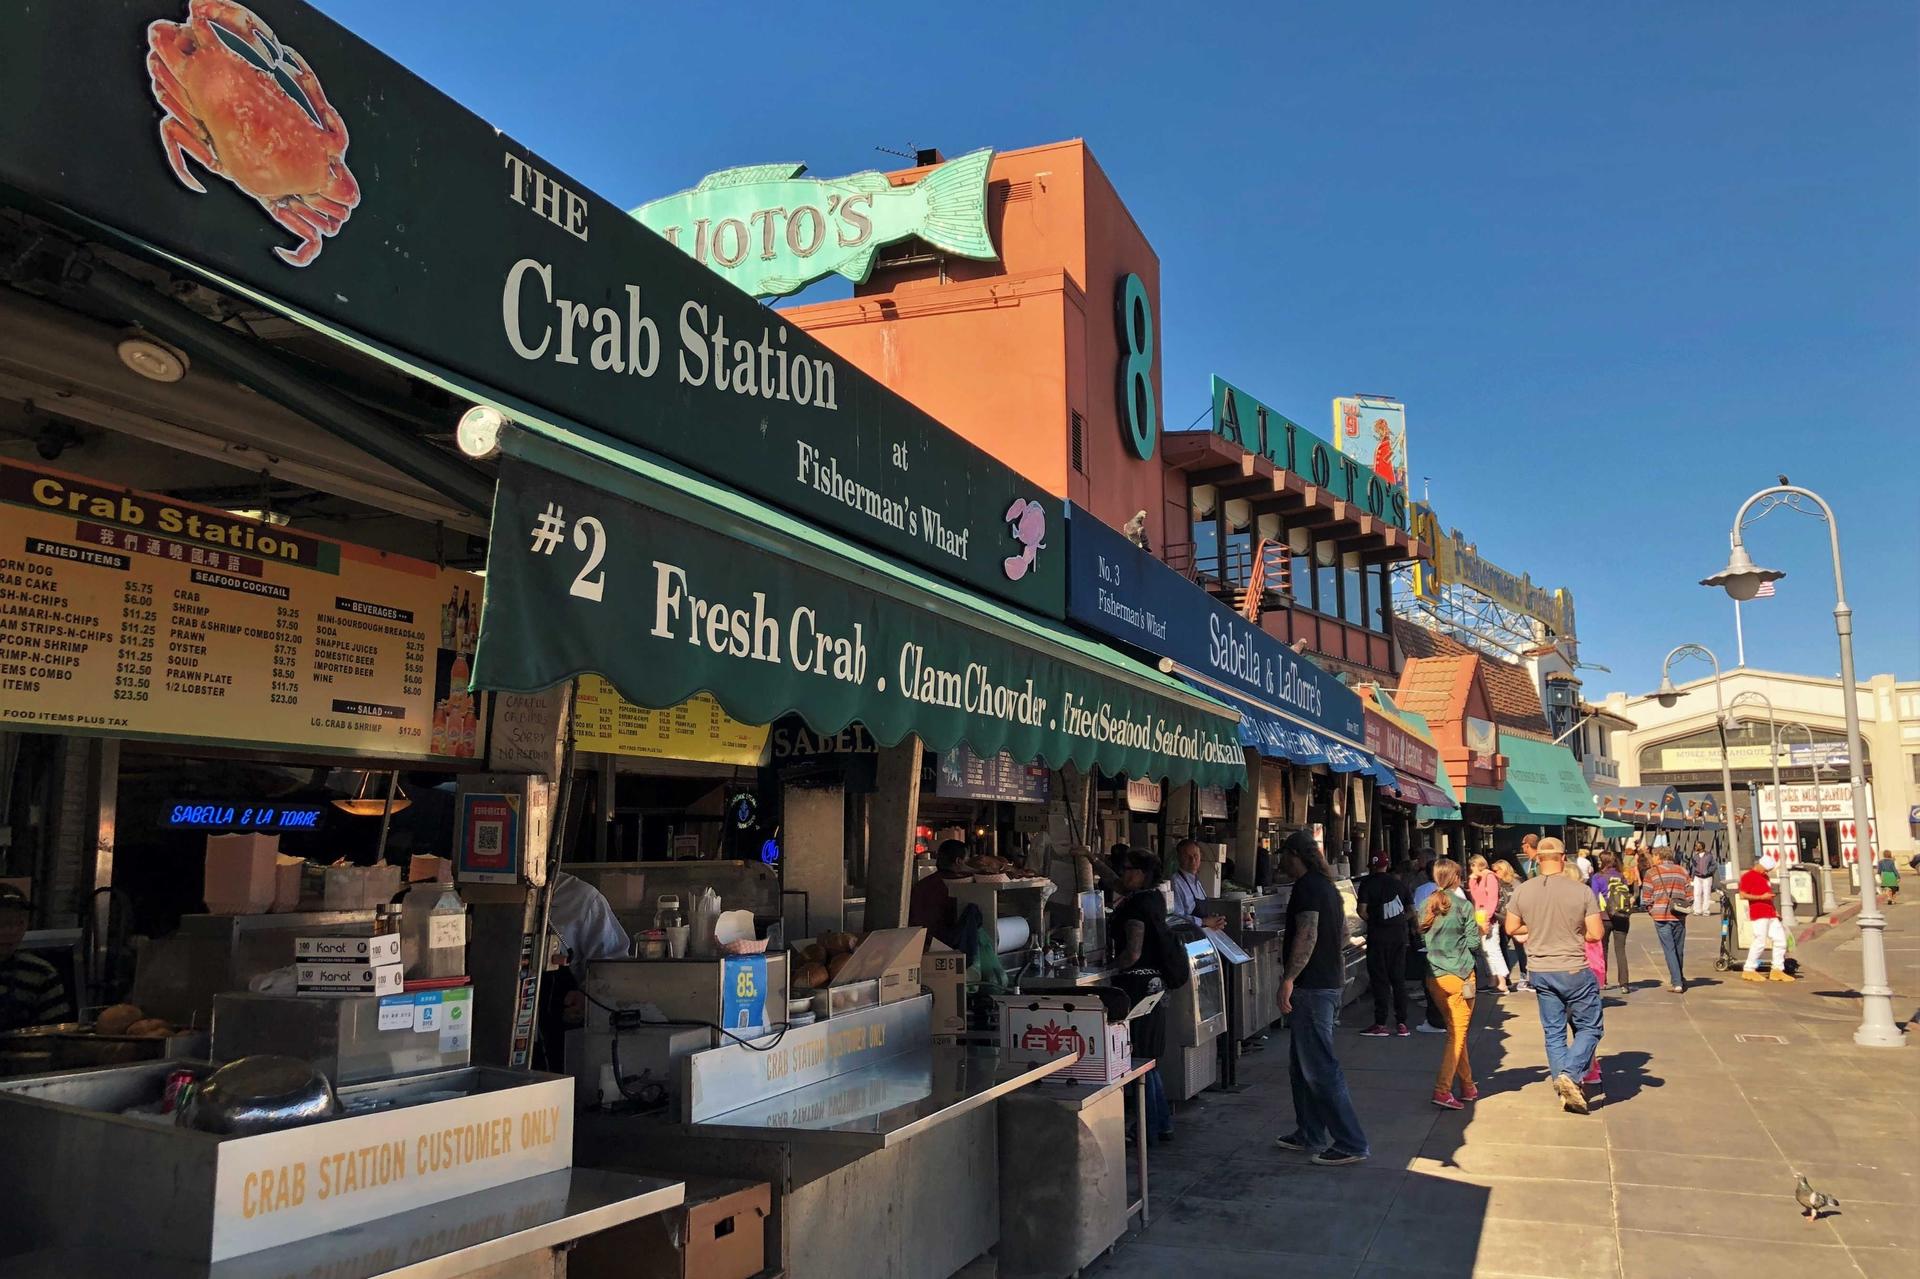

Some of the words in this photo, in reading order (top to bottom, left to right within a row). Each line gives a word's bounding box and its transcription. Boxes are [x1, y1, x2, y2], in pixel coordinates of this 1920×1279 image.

[504, 151, 589, 242] THE
[503, 258, 661, 379] Crab
[678, 299, 838, 411] Station
[1114, 272, 1157, 462] 8
[891, 441, 909, 472] at
[1218, 387, 1406, 531] ALIOTO'S
[795, 439, 918, 537] Fisherman's
[920, 506, 969, 560] Wharf
[32, 478, 145, 525] Crab
[158, 507, 299, 560] Station
[37, 542, 78, 559] FRIED
[81, 551, 121, 567] ITEMS
[530, 501, 607, 602] #2
[0, 559, 25, 572] ORN
[28, 563, 53, 576] DOG
[124, 580, 153, 595] $5.75
[1098, 555, 1112, 582] No.
[1114, 564, 1120, 586] 3
[0, 573, 22, 586] RAB
[25, 578, 57, 592] CAKE
[124, 593, 152, 607] $6.00
[195, 572, 241, 588] SEAFOOD
[242, 581, 288, 597] COCKTAIL
[122, 607, 157, 622] $11.25
[172, 602, 210, 617] SHRIMP
[276, 619, 299, 631] $7.50
[174, 589, 200, 602] CRAB
[277, 606, 300, 619] $9.25
[352, 602, 397, 619] BEVERAGES
[1098, 587, 1145, 630] Fisherman's
[1146, 611, 1167, 641] Wharf
[0, 604, 100, 627] LAMARI-N-CHIPS
[121, 621, 156, 636] $11.25
[171, 615, 198, 628] CRAB
[207, 621, 242, 635] SHRIMP
[244, 627, 275, 640] COMBO
[275, 631, 303, 644] $12.00
[317, 613, 384, 634] MINI-SOURDOUGH
[21, 621, 114, 643] STRIPS-N-CHIPS
[119, 634, 155, 648] $11.25
[170, 628, 206, 642] PRAWN
[274, 644, 297, 656] $7.75
[316, 625, 337, 637] SODA
[406, 642, 425, 652] $2.75
[651, 560, 781, 664] Fresh
[789, 606, 867, 686] Crab
[899, 641, 962, 709] Clam
[965, 662, 1047, 727] Chowder
[44, 639, 89, 654] SHRIMP
[118, 648, 153, 662] $11.25
[169, 641, 207, 656] OYSTER
[273, 655, 296, 668] $9.75
[314, 649, 354, 664] DOMESTIC
[355, 655, 375, 666] BEER
[315, 637, 351, 651] SNAPPLE
[351, 643, 378, 655] JUICES
[405, 652, 424, 663] $4.00
[0, 664, 26, 676] EMS
[30, 666, 72, 681] COMBO
[115, 675, 150, 689] $13.50
[116, 662, 152, 676] $12.50
[167, 655, 199, 668] SQUID
[272, 668, 295, 680] $8.50
[314, 661, 353, 675] IMPORTED
[354, 667, 374, 678] BEER
[1209, 612, 1261, 688] Sabella
[1265, 658, 1274, 695] &
[1278, 654, 1322, 717] LaTorre's
[3, 678, 41, 692] ITEMS
[113, 689, 149, 702] $23.50
[166, 668, 202, 682] PRAWN
[203, 672, 233, 685] PLATE
[271, 680, 299, 693] $11.75
[313, 673, 334, 684] WINE
[165, 682, 180, 693] 1/2
[182, 683, 225, 697] LOBSTER
[270, 693, 298, 705] $23.00
[3, 709, 36, 720] FOOD
[39, 712, 74, 722] ITEMS
[77, 715, 105, 725] PLUS
[108, 718, 128, 727] TAX
[357, 703, 383, 716] SALAD
[311, 717, 324, 727] LG.
[325, 719, 345, 730] CRAB
[354, 722, 382, 733] SHRIMP
[398, 726, 421, 737] $17.50
[774, 725, 879, 757] SABEL
[1129, 781, 1159, 802] ENTRANCE
[170, 805, 234, 824] SABELLA
[241, 808, 253, 825] &
[255, 808, 274, 825] LA
[279, 810, 321, 827] TORRE
[316, 942, 346, 953] Karat
[320, 970, 351, 982] Karat
[767, 1052, 788, 1081] CRAB
[793, 1039, 825, 1072] STATION
[869, 1023, 886, 1048] ONLY
[242, 1162, 306, 1219] CRAB
[318, 1140, 406, 1200] STATION
[417, 1117, 511, 1176] CUSTOMER
[521, 1106, 561, 1148] ONLY
